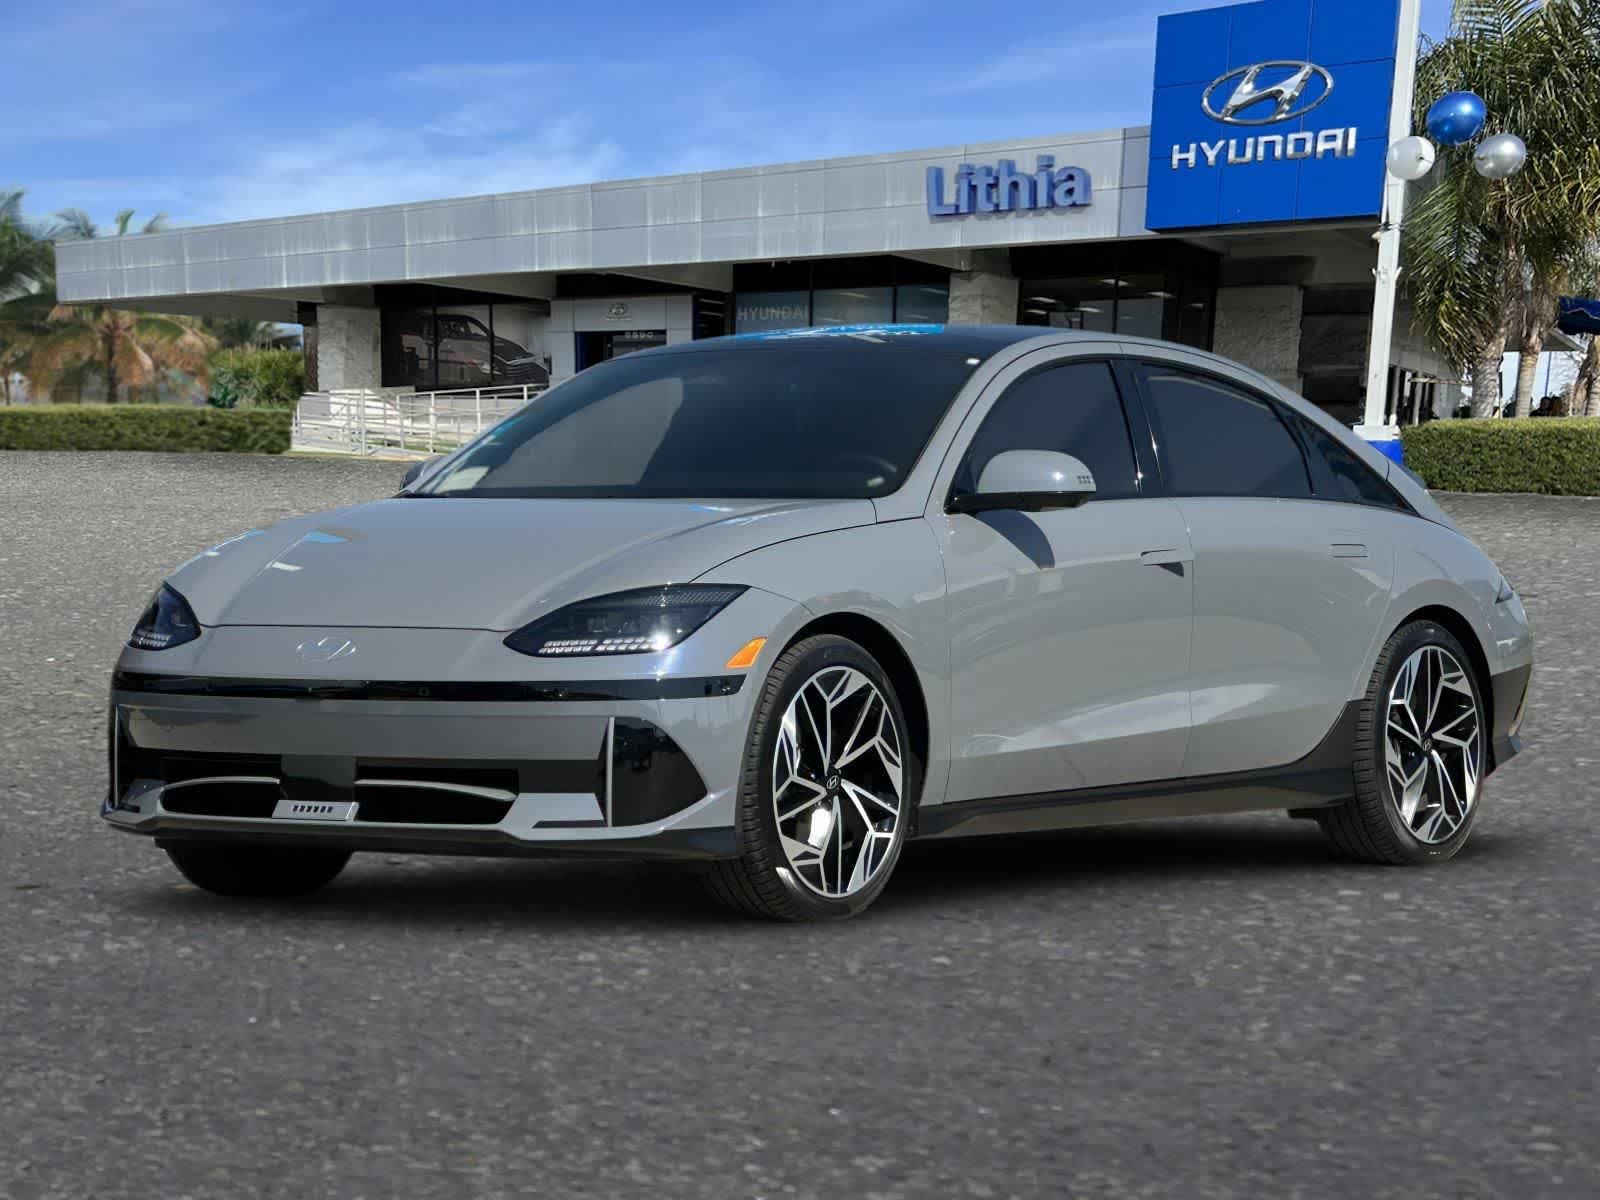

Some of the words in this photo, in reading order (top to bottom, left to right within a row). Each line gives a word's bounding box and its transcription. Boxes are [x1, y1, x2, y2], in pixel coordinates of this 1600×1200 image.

[1171, 127, 1358, 169] HYUNDAI
[926, 155, 1092, 218] Lithia
[737, 304, 809, 321] HYUNDAI
